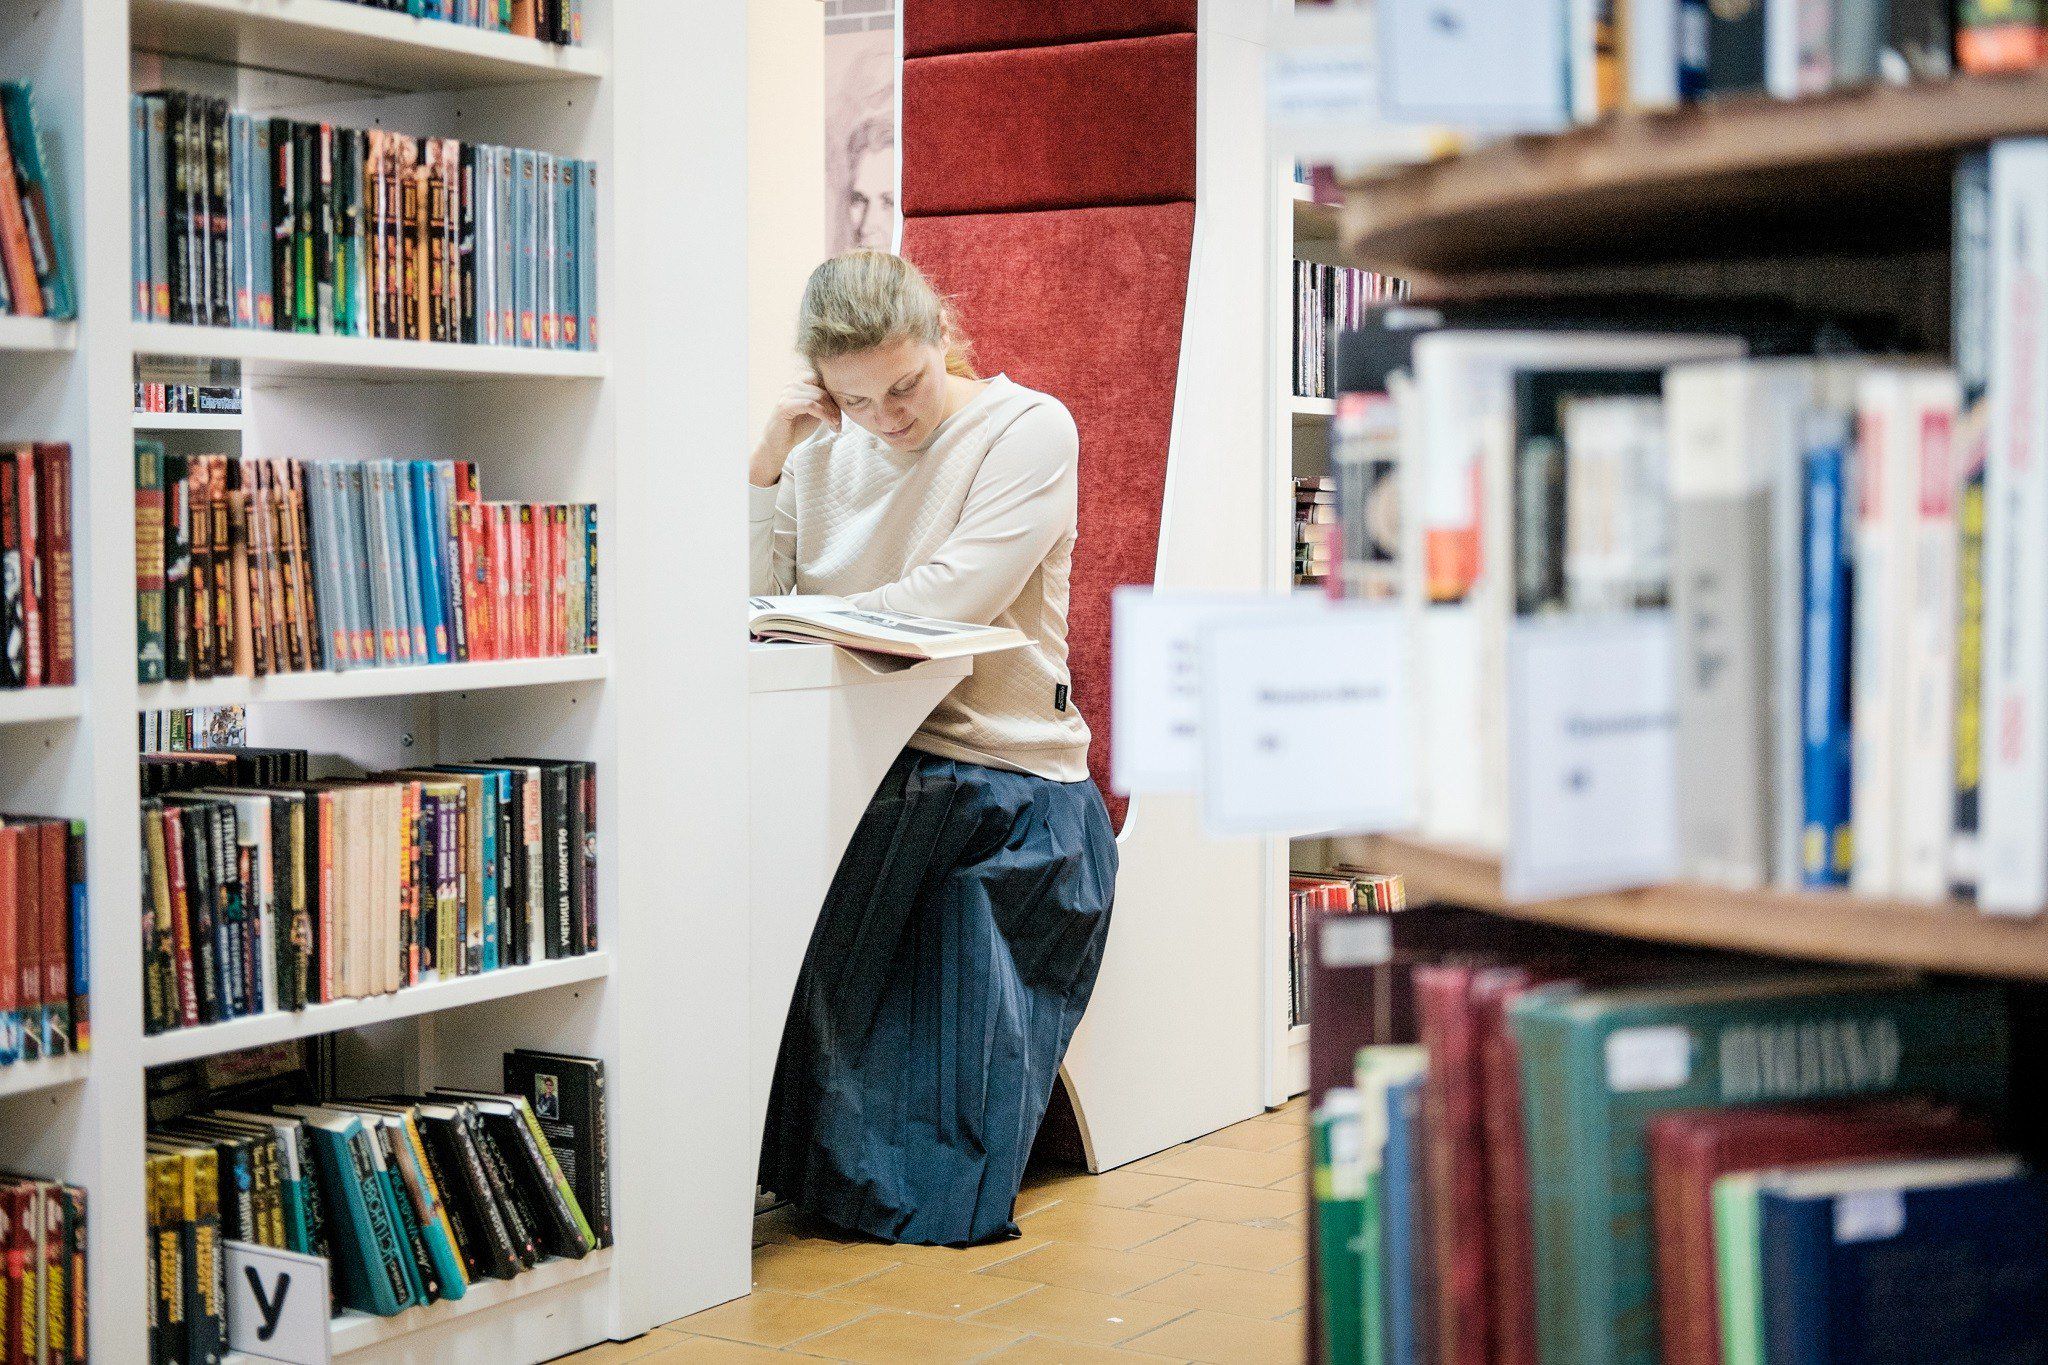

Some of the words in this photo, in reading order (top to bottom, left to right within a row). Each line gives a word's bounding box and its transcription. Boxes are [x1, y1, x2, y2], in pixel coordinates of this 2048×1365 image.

[557, 827, 569, 892] КАЛИОСТРО
[559, 895, 570, 946] УЧЕНИЦА
[358, 1175, 398, 1264] УСТИНОВА
